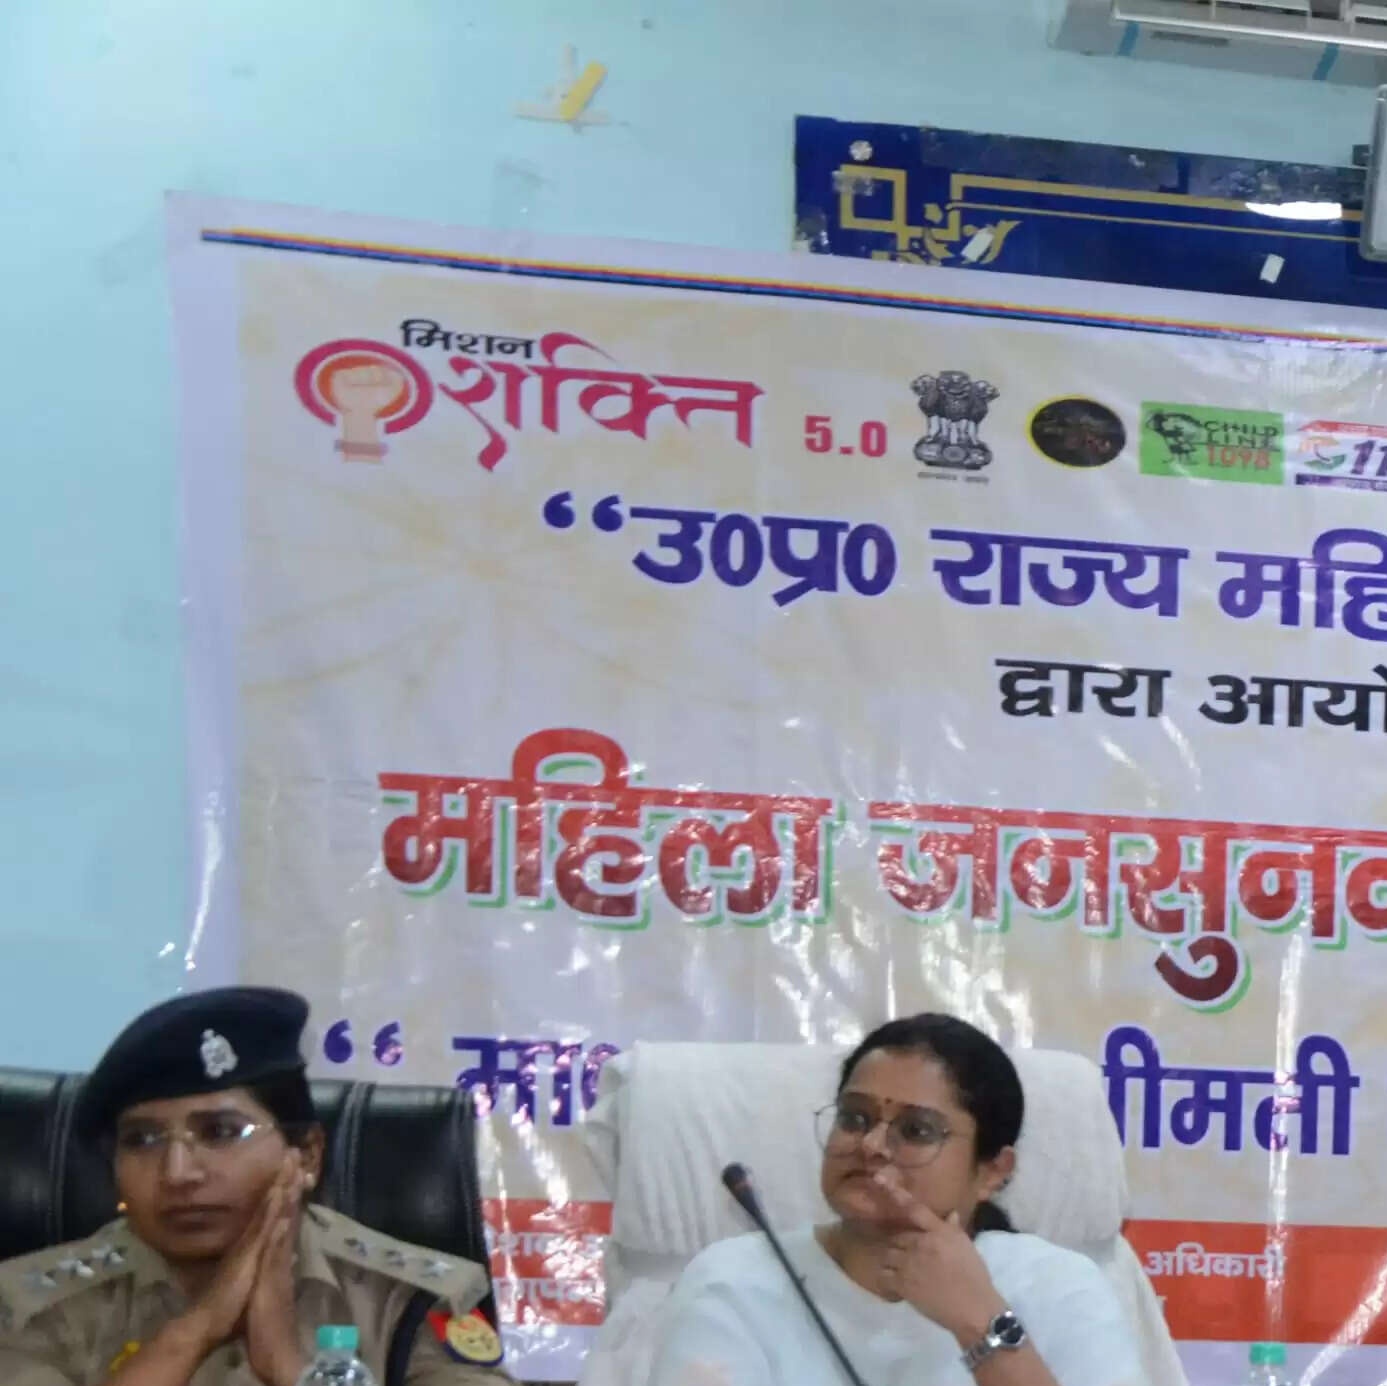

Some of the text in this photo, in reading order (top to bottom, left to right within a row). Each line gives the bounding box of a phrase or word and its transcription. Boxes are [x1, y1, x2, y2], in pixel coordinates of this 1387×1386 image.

[400, 318, 536, 359] मिशन
[437, 331, 764, 473] शक्ति
[804, 414, 888, 459] 5.0
[1204, 420, 1279, 437] CHILD
[1207, 447, 1271, 470] 1098
[930, 529, 1189, 618] राज्य
[995, 658, 1172, 718] द्वारा
[378, 727, 832, 917] महिला
[1143, 1241, 1287, 1281] अधिकारी
